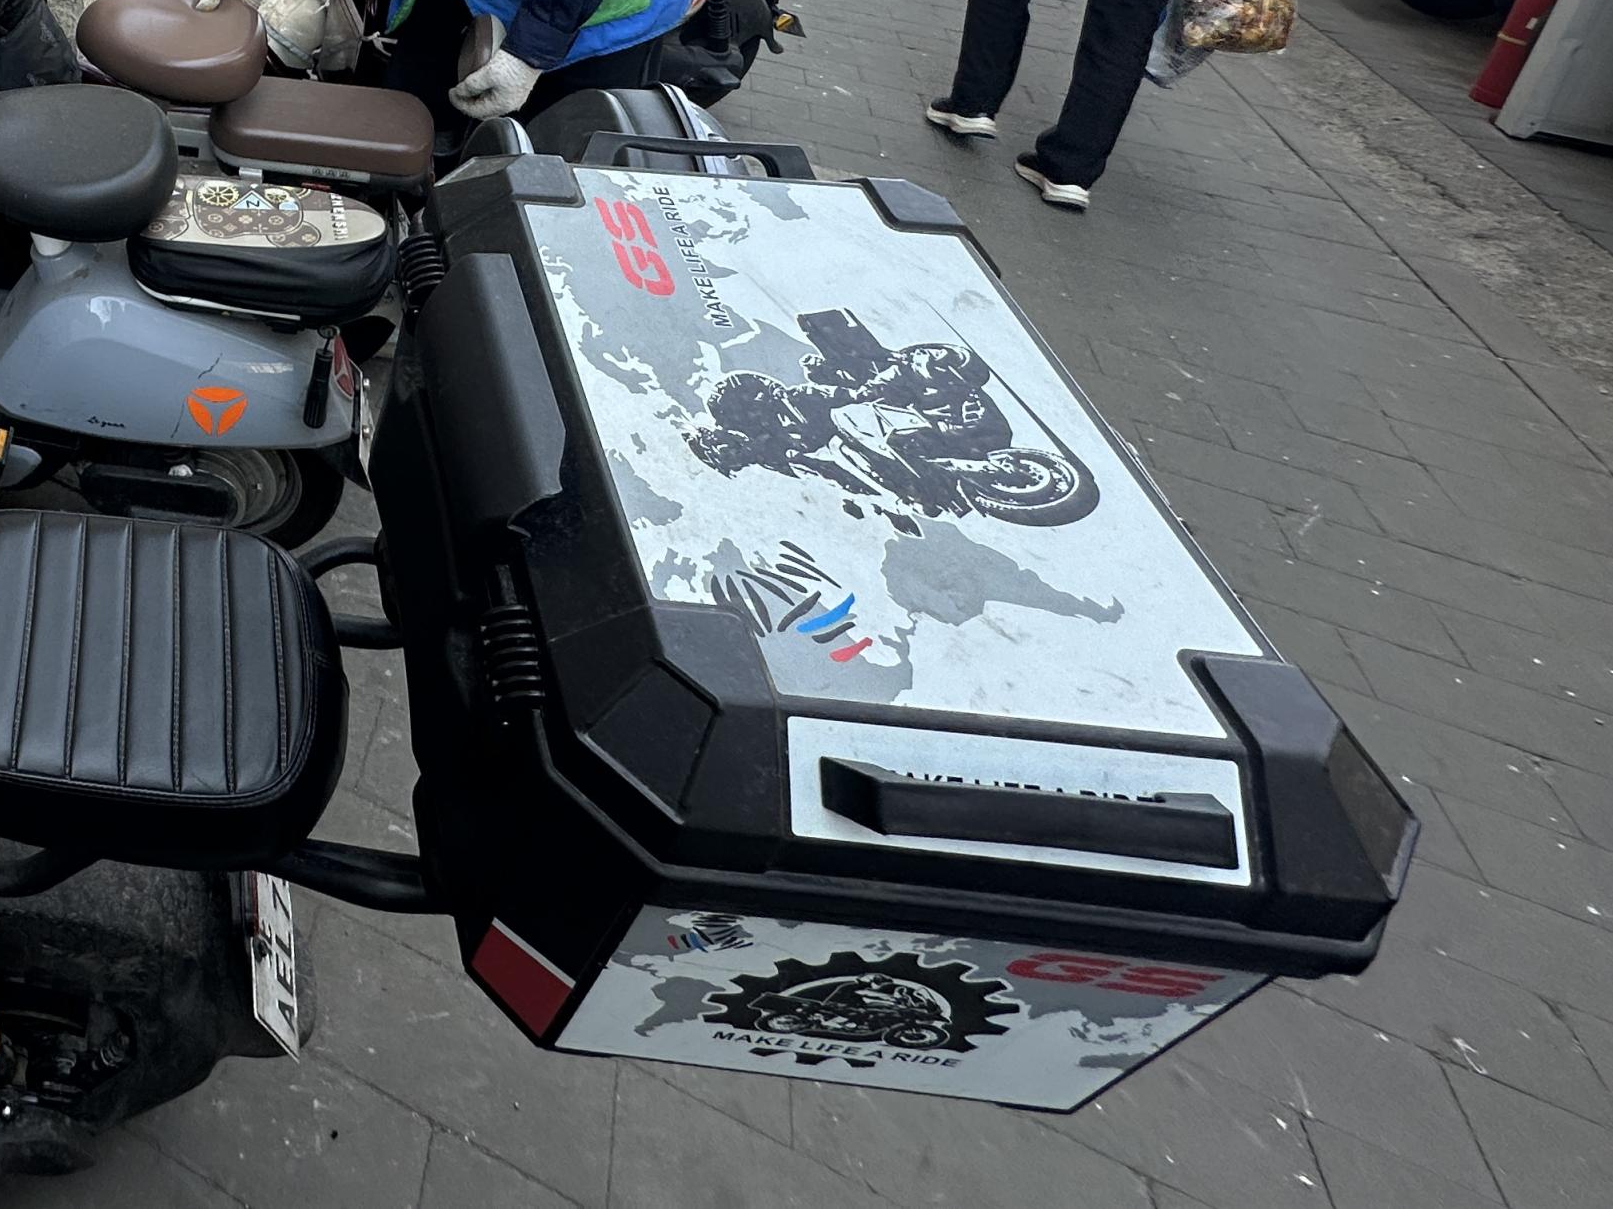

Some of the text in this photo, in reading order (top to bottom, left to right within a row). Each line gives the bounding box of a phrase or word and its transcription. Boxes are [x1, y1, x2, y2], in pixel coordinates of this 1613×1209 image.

[593, 195, 676, 297] GS
[652, 185, 735, 329] MAKE LIFE A RIDE
[1005, 952, 1227, 999] GS
[712, 1030, 962, 1068] MAKE LIFE A RIDE
